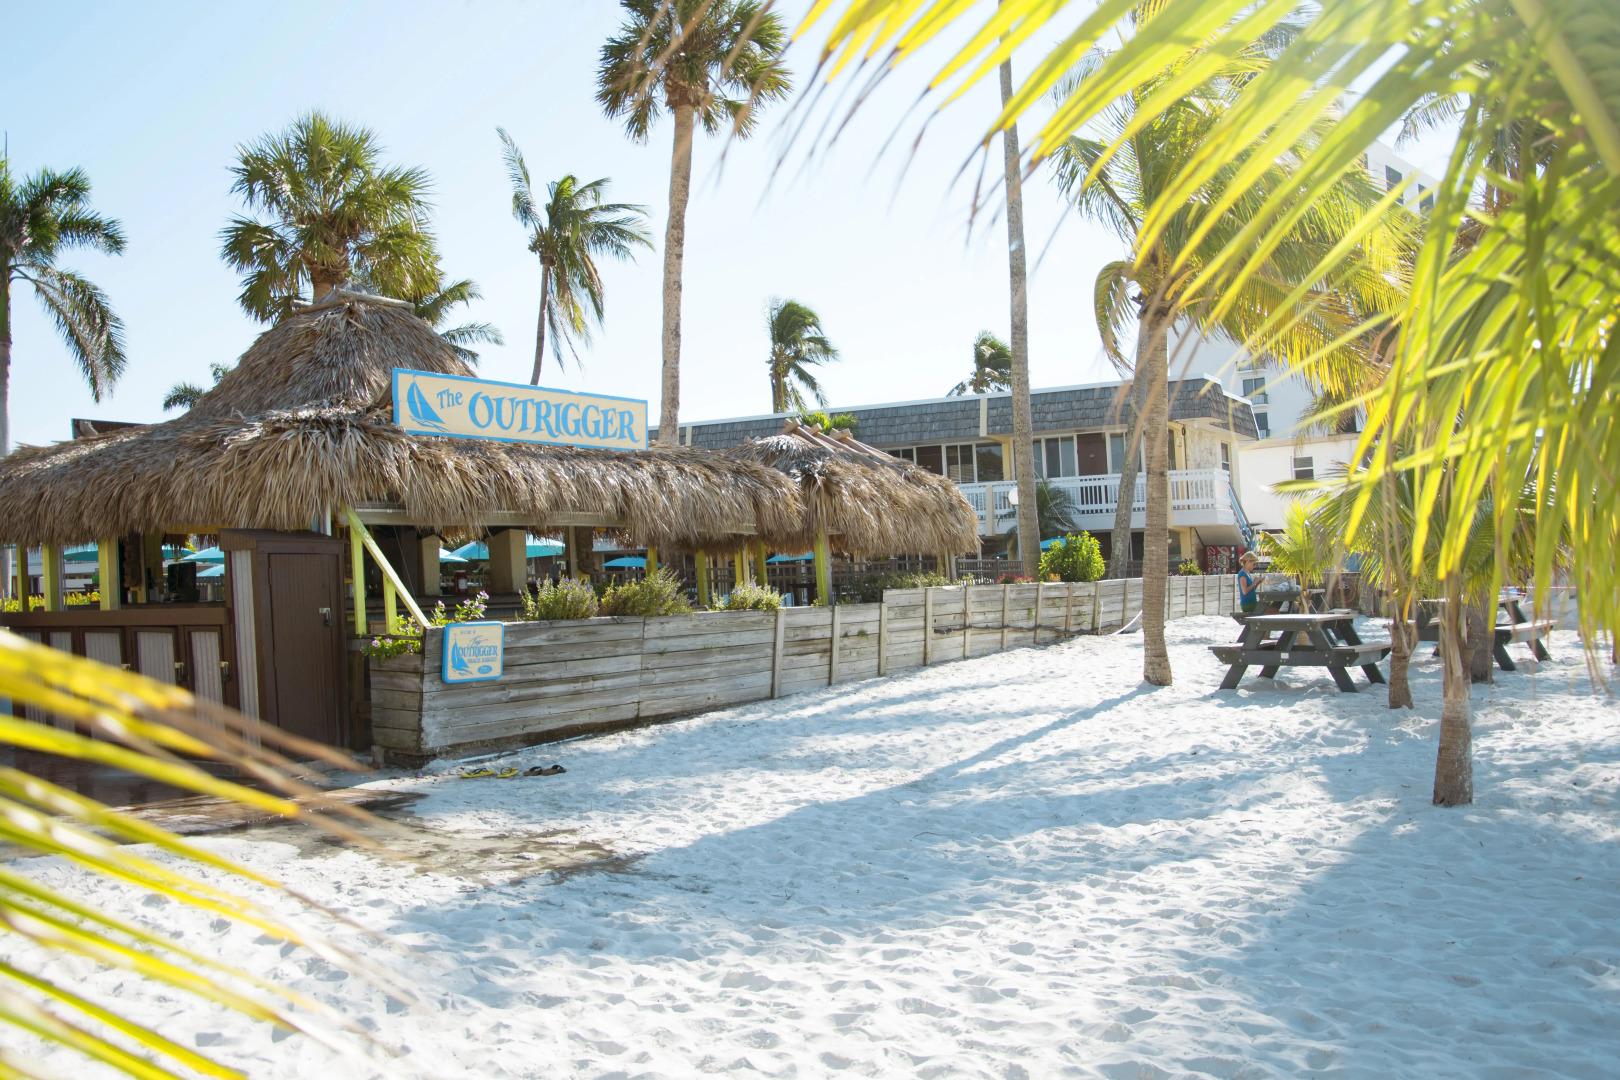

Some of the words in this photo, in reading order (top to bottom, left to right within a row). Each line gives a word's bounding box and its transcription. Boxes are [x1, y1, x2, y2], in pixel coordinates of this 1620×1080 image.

[437, 388, 463, 410] The
[468, 391, 641, 443] OUTRIGGER
[458, 645, 498, 658] OUTRIGGER
